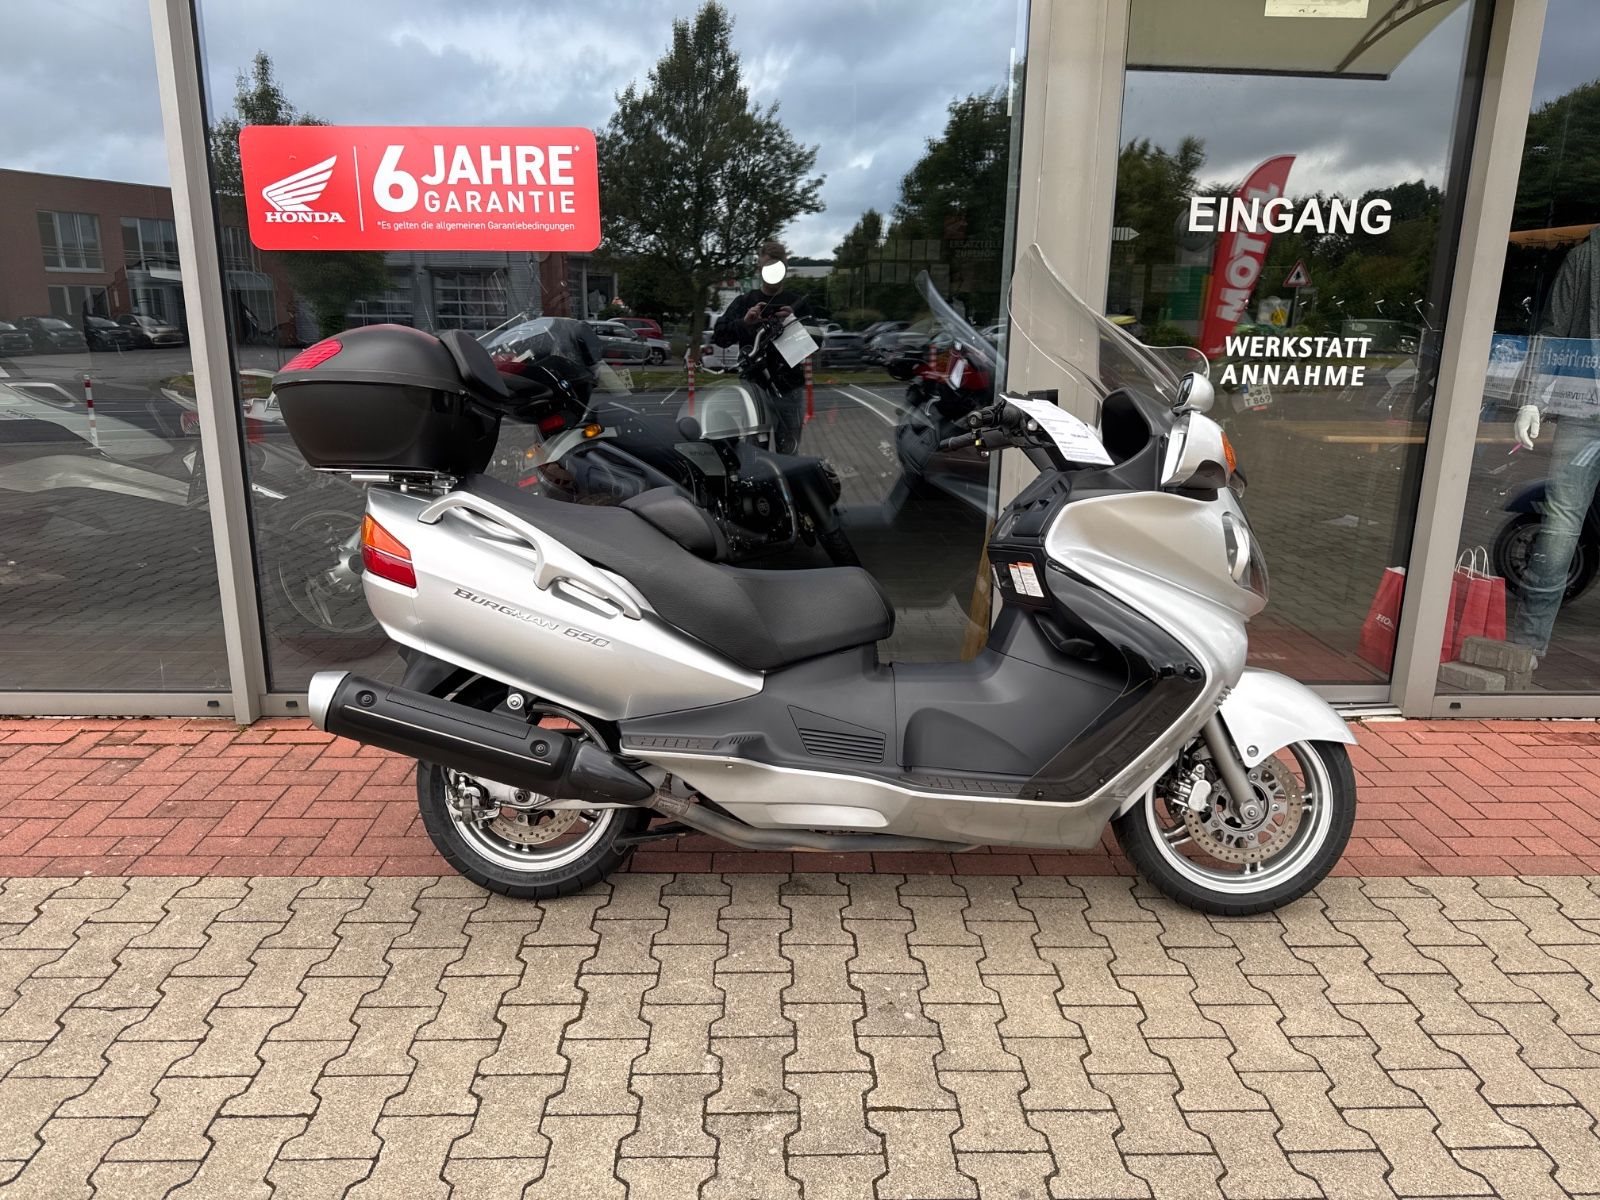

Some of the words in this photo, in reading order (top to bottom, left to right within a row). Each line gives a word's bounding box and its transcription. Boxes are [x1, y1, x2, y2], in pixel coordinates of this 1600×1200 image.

[373, 145, 419, 213] 6
[424, 190, 576, 213] GARANTIE
[265, 212, 346, 223] HONDA
[393, 221, 419, 231] gelten
[421, 221, 434, 230] die
[436, 221, 486, 232] allgemeinen
[487, 221, 575, 232] Garantiebedingungen
[1188, 196, 1393, 235] EINGANG
[1225, 335, 1372, 359] WERKSTATT
[1220, 364, 1366, 386] ANNAHME
[453, 587, 559, 631] BURGMAN
[563, 627, 611, 648] 650
